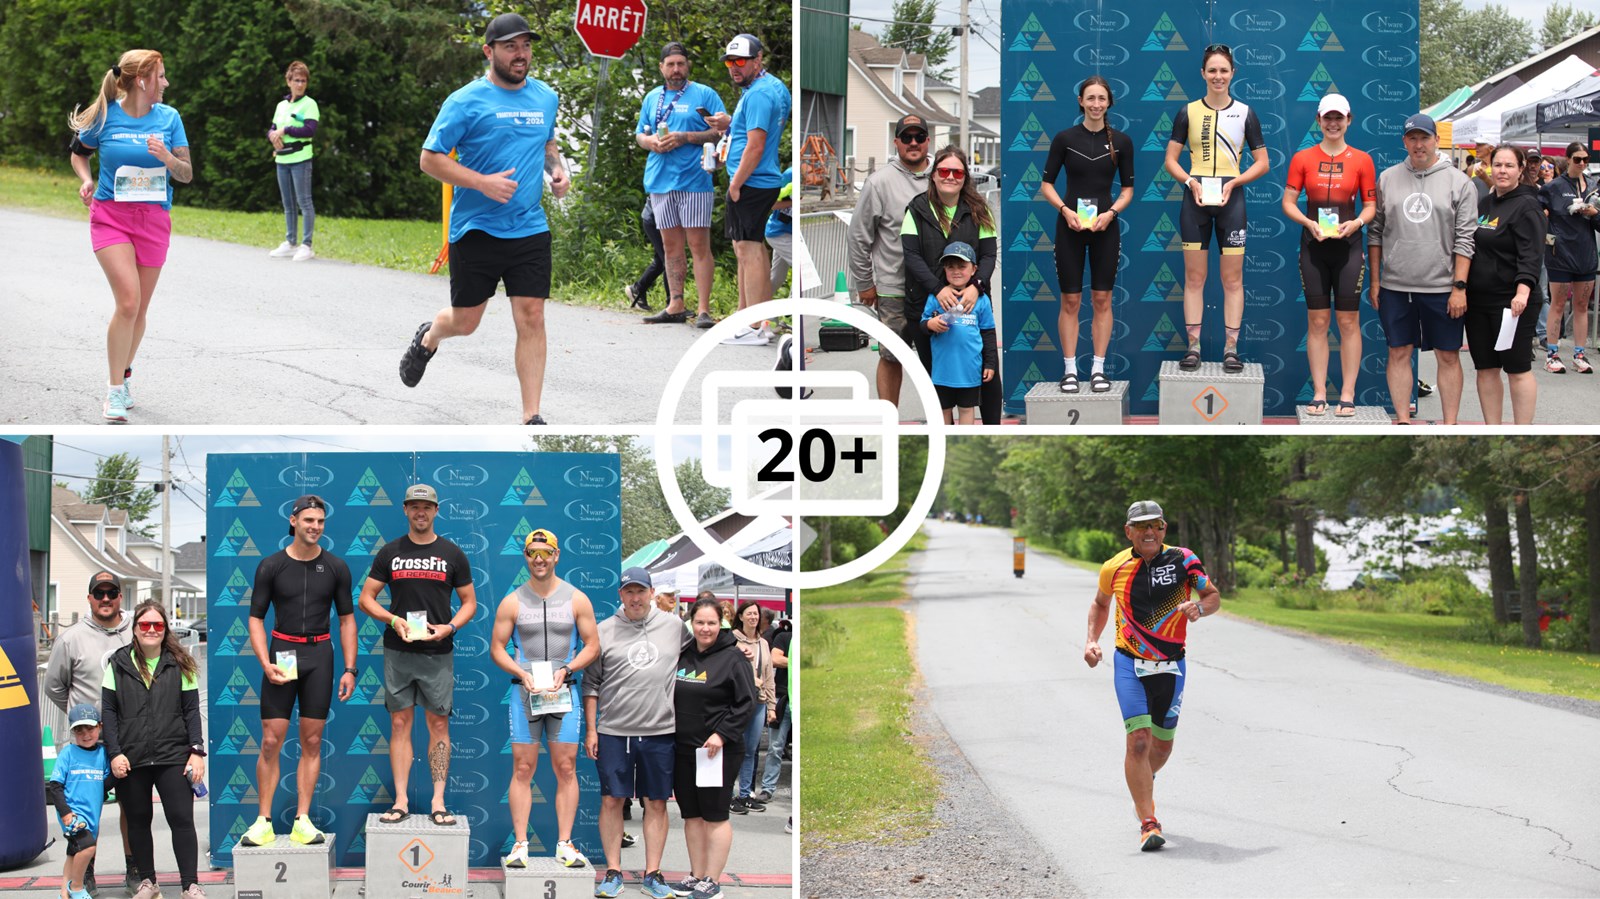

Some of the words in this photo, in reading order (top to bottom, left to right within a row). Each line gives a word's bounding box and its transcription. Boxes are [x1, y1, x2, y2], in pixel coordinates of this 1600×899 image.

[579, 3, 643, 33] ARRÊT
[525, 117, 545, 125] 2024
[1201, 115, 1212, 140] MONSTRE
[1204, 393, 1214, 414] 1
[1067, 409, 1080, 425] 2
[392, 556, 447, 572] CrossFit
[1156, 564, 1176, 576] SP
[1152, 574, 1172, 587] MS
[410, 845, 420, 866] 1
[274, 862, 288, 882] 2
[402, 880, 430, 888] Courir
[428, 886, 462, 894] Beauce
[544, 880, 556, 899] 3
